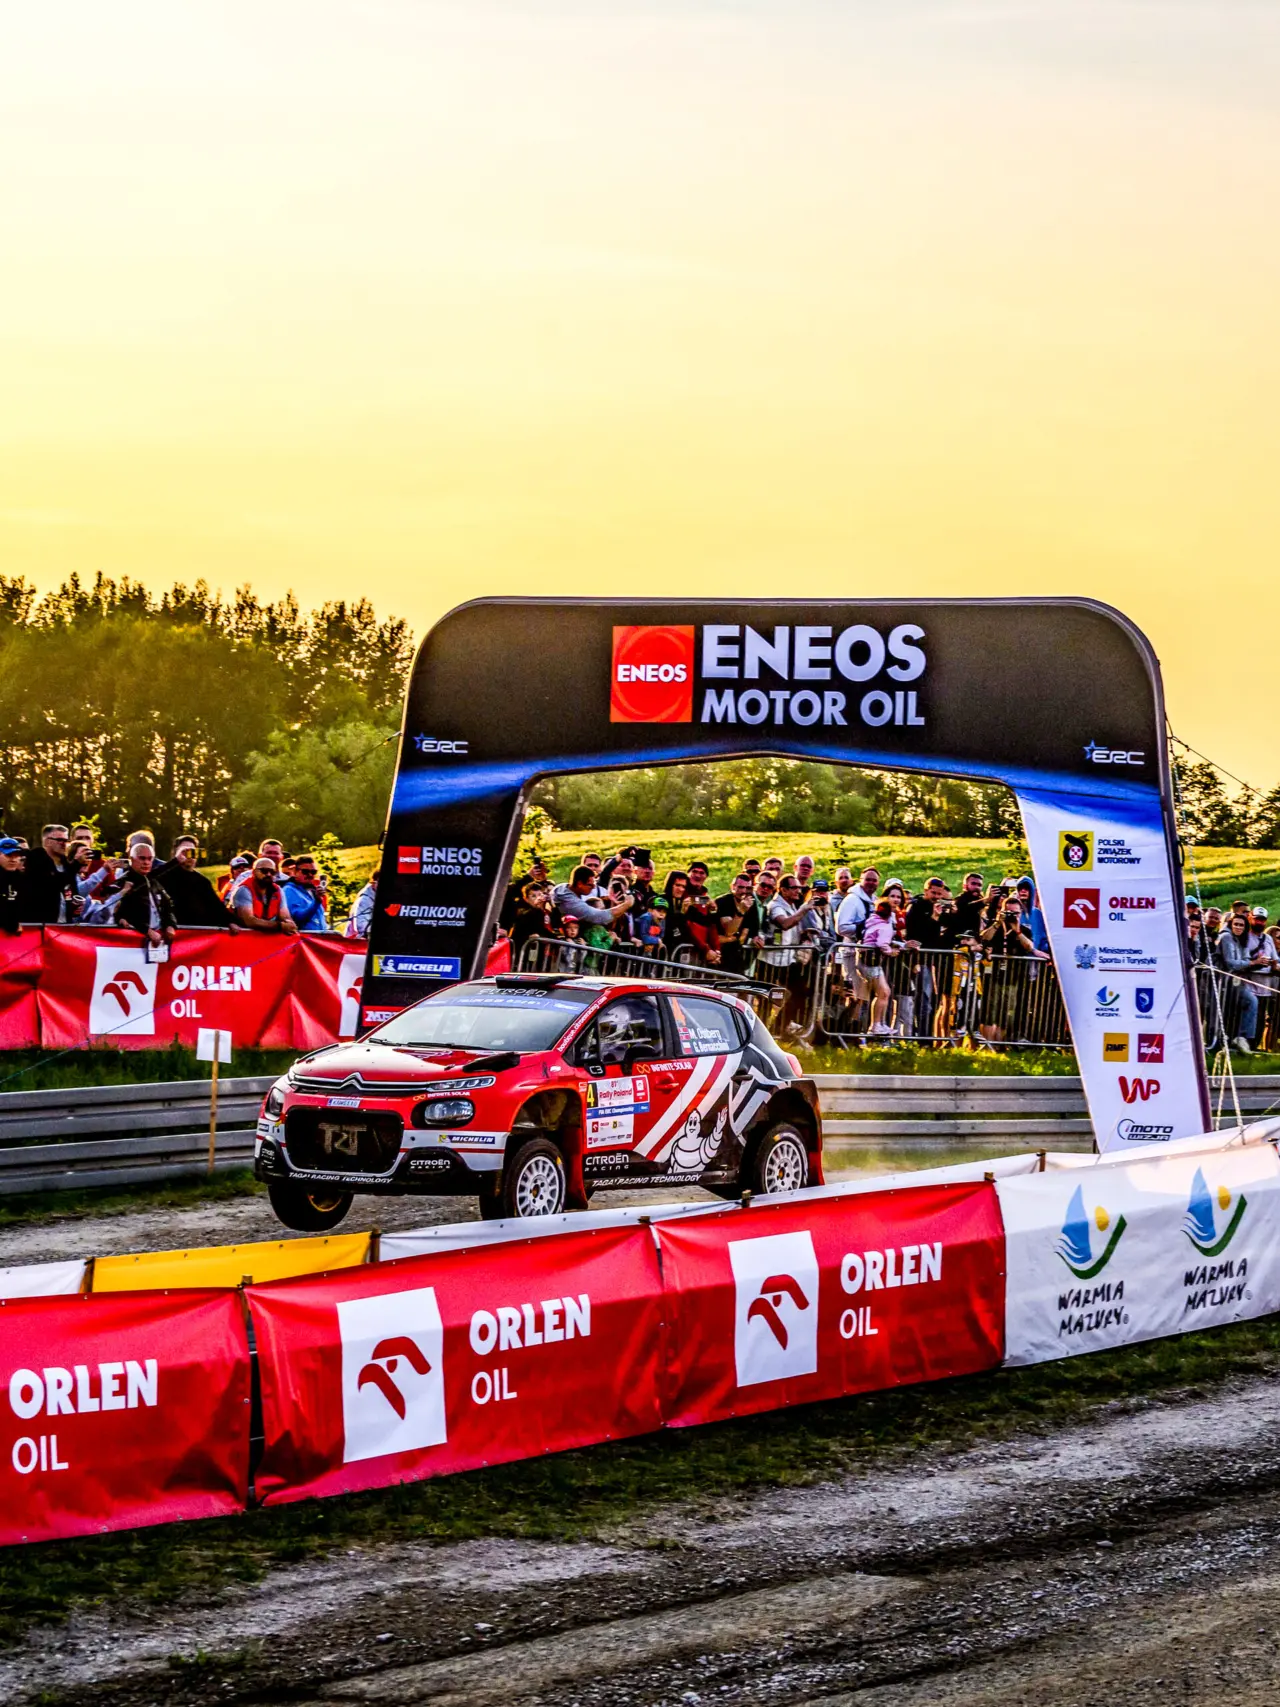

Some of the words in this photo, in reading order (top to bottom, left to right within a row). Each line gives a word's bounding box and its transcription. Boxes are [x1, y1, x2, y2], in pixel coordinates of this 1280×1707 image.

[702, 624, 927, 683] ENEOS
[617, 662, 687, 683] ENEOS
[701, 688, 848, 726] MOTOR
[860, 689, 925, 726] OIL
[422, 740, 469, 754] ERC
[1092, 750, 1145, 765] ERC
[1098, 839, 1125, 847] POLSKI
[422, 846, 482, 864] ENEOS
[1097, 857, 1141, 865] MOTOROWY
[422, 864, 461, 875] MOTOR
[464, 865, 482, 876] OIL
[1109, 896, 1156, 909] ORLEN
[1109, 912, 1126, 922] OIL
[1099, 947, 1143, 955] Ministerstwo
[397, 963, 453, 973] MICHELIN
[171, 965, 252, 992] ORLEN
[170, 1000, 203, 1019] OIL
[1105, 1043, 1127, 1052] RMF
[586, 1083, 595, 1108] 4
[1118, 1075, 1161, 1104] WP
[342, 1176, 393, 1184] TECHNOLOGY
[616, 1176, 648, 1186] RACING
[650, 1173, 702, 1183] TECHNOLOGY
[840, 1242, 944, 1296] ORLEN
[1184, 1258, 1248, 1287] WARMIA
[1057, 1280, 1125, 1311] WARMIA
[469, 1293, 591, 1356] ORLEN
[838, 1305, 879, 1341] OIL
[9, 1358, 158, 1420] ORLEN
[471, 1369, 517, 1406] OIL
[11, 1436, 69, 1475] OIL
